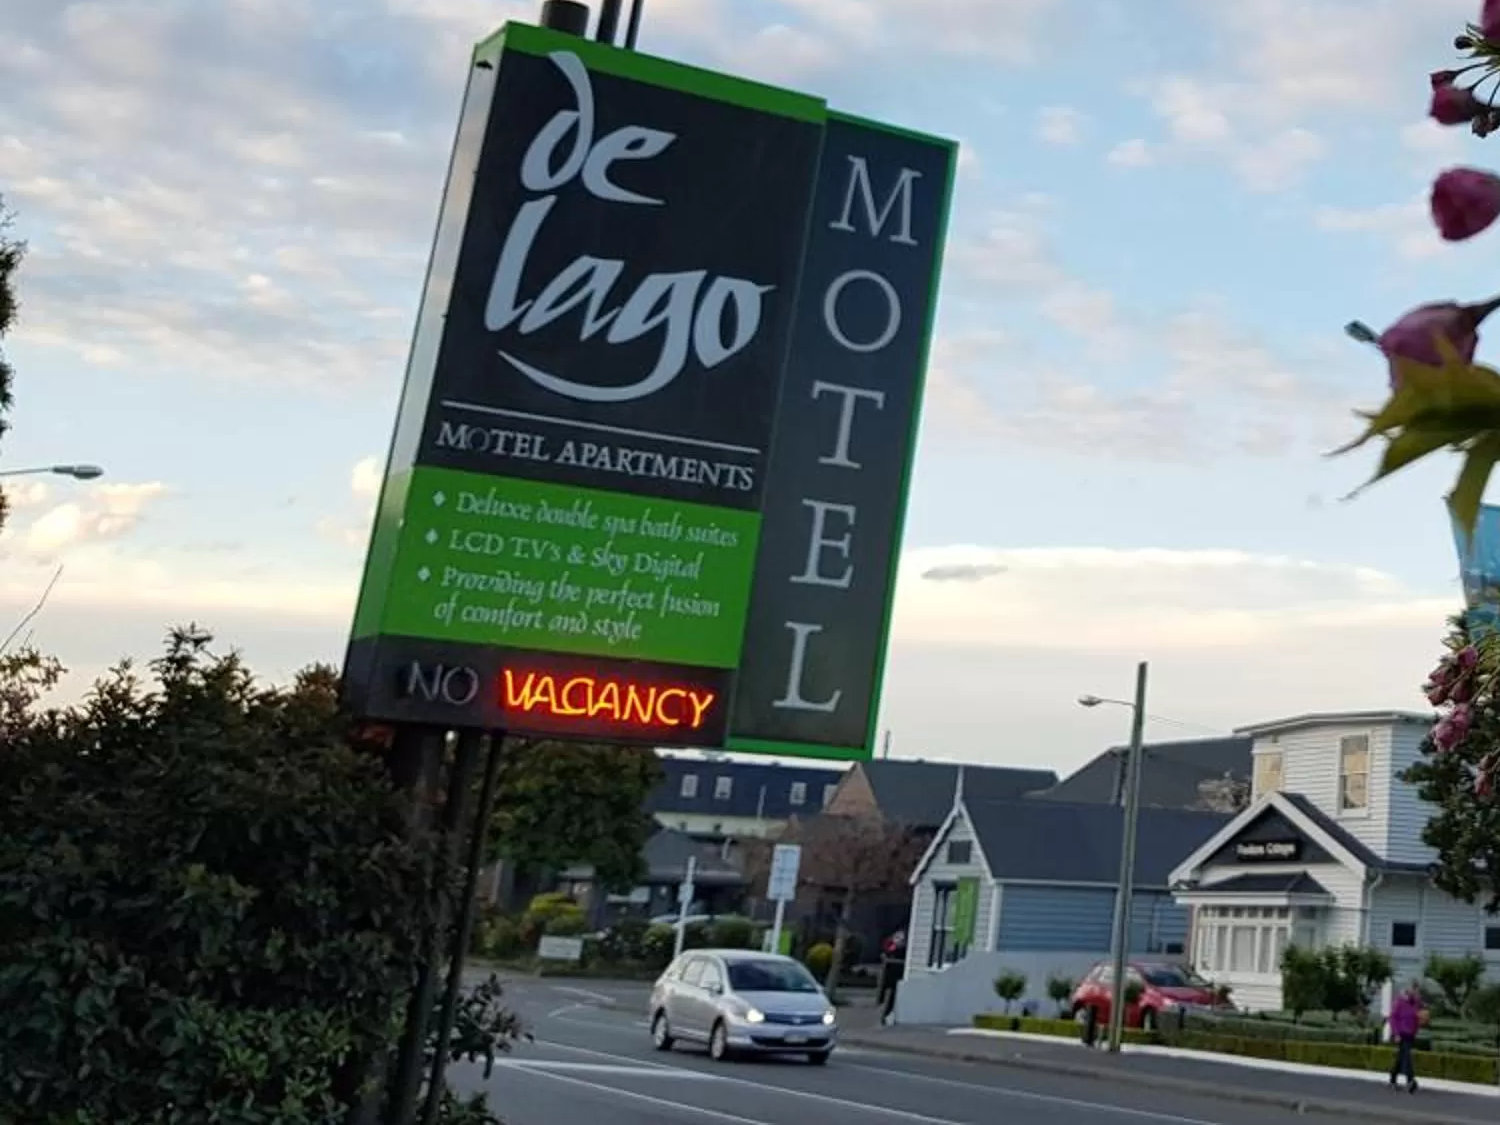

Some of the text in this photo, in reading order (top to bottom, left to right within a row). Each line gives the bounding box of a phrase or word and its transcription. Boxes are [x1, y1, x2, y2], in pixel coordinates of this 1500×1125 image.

[520, 50, 679, 206] de
[484, 194, 778, 402] lago
[436, 422, 755, 492] MOTEL APARTMENTS
[771, 154, 923, 713] MOTEL
[456, 487, 739, 548] Deluxe double spa bath suites
[448, 529, 505, 557] LCD
[566, 545, 587, 565] &
[591, 540, 628, 577] Sky
[634, 551, 705, 581] Digital
[433, 590, 643, 645] of comfort and style
[440, 565, 721, 618] Providing the perfect fusion
[407, 660, 715, 729] NO VACANCY
